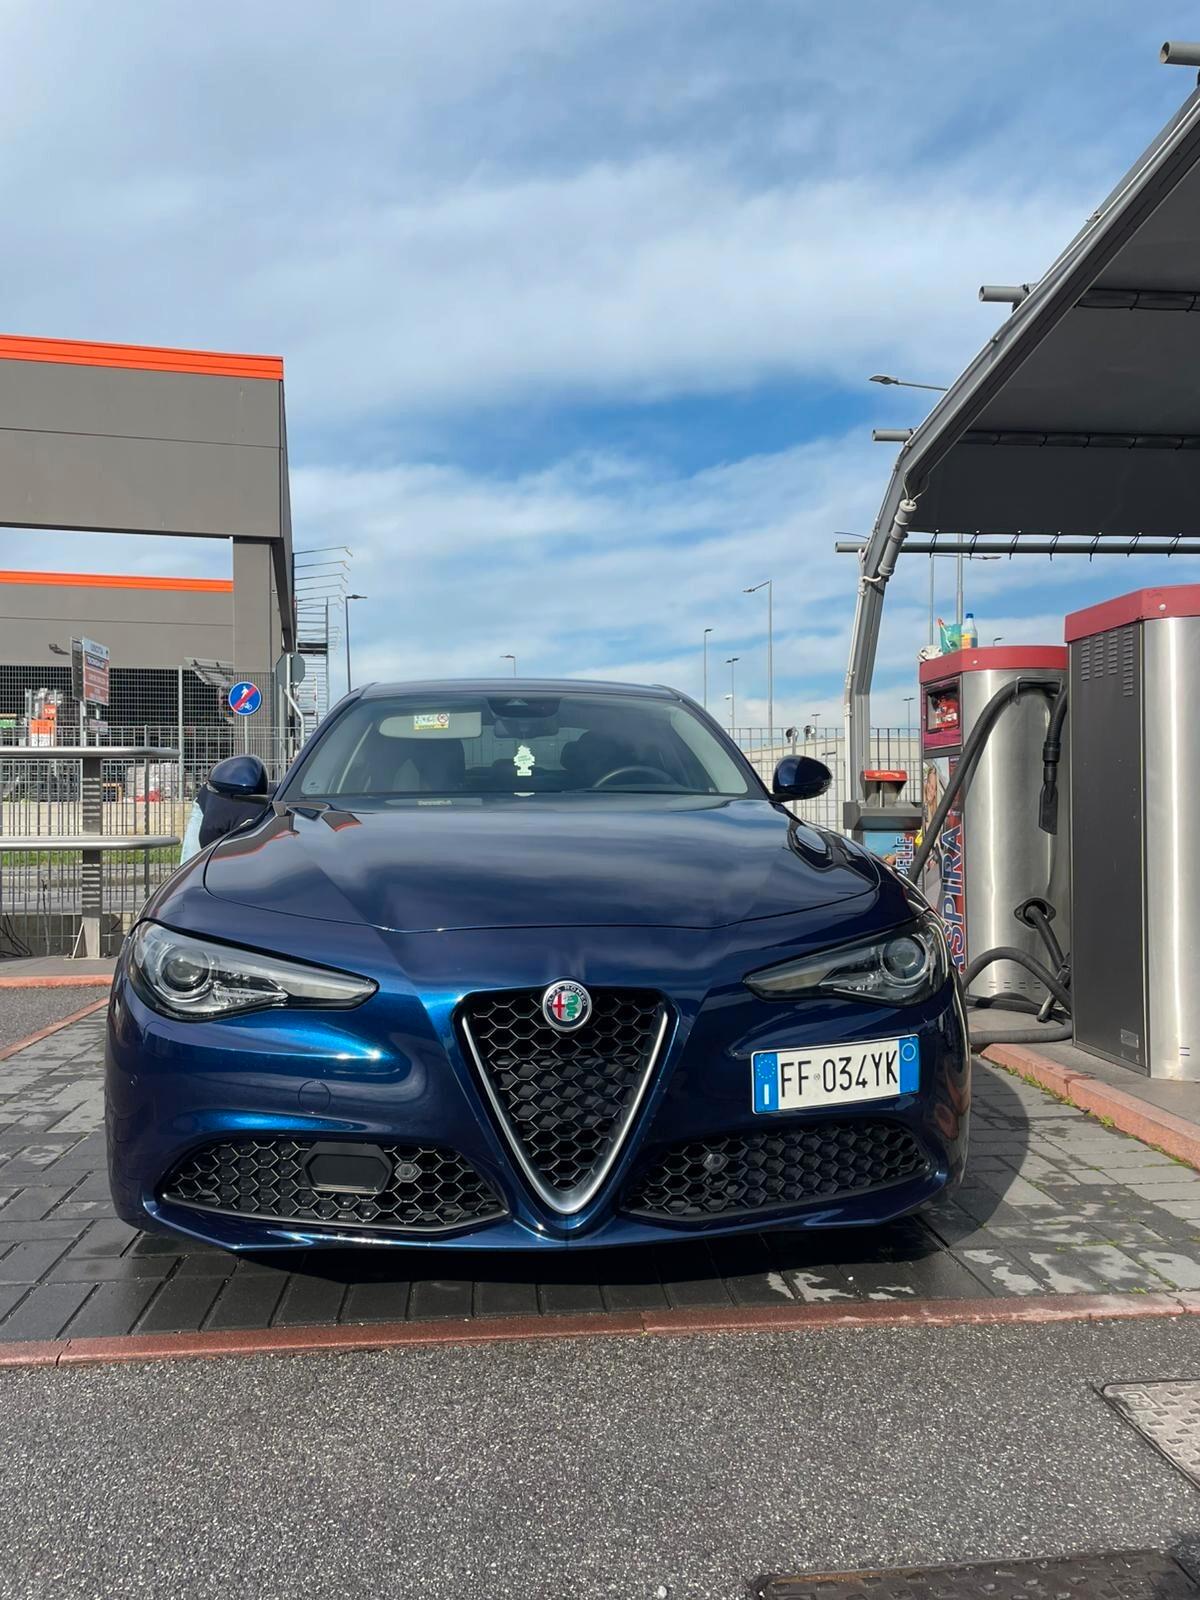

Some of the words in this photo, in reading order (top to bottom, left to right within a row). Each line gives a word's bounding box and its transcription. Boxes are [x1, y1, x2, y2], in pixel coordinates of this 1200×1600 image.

[547, 987, 561, 1007] ALFA
[564, 983, 588, 1007] ROMEO
[780, 1061, 811, 1097] FF
[823, 1050, 897, 1092] 034YK
[764, 1084, 769, 1105] I
